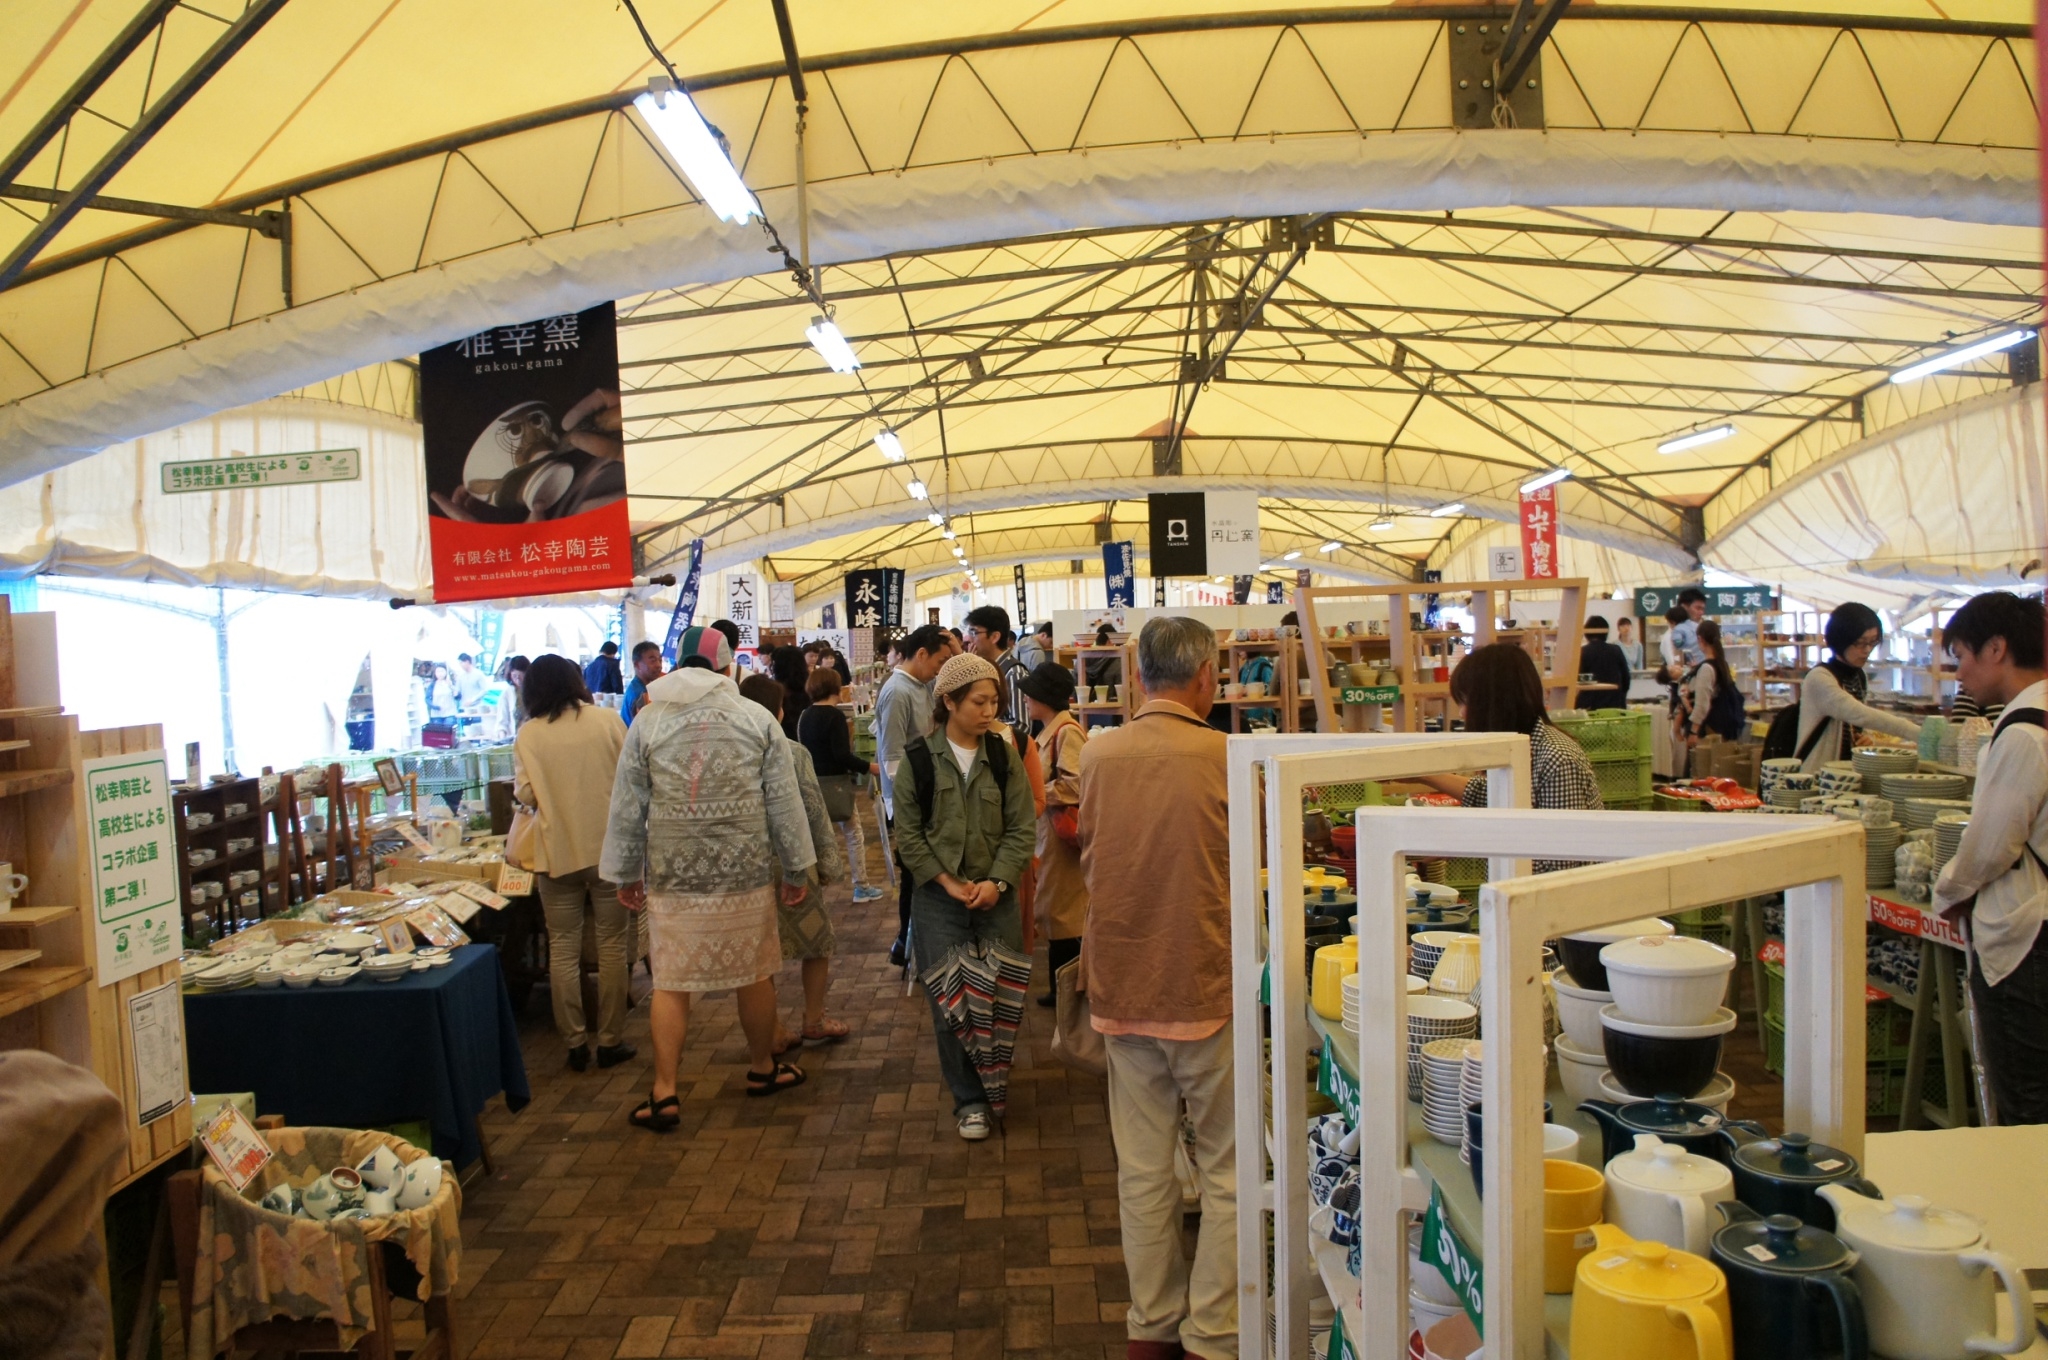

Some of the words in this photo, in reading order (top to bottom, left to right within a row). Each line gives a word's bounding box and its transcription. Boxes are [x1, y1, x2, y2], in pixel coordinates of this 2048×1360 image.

[475, 357, 564, 375] gakou-gama
[172, 459, 288, 477] 松幸陶芸と高校生による
[172, 473, 225, 488] コラボ企画
[452, 547, 512, 566] 有限会社
[520, 535, 610, 564] 松幸陶芸
[453, 561, 611, 583] www.matsukou-gakougama.com
[731, 576, 753, 644] 大新窯
[854, 578, 882, 628] 永峰
[1345, 690, 1376, 702] 30%
[1376, 693, 1395, 701] OFF
[95, 776, 152, 804] 松幸陶芸と
[98, 807, 166, 839] 高校生による
[102, 841, 159, 872] コラボ企画
[104, 878, 147, 908] 第二弾！
[1872, 900, 1898, 924] 50%
[1897, 915, 1917, 930] OFF
